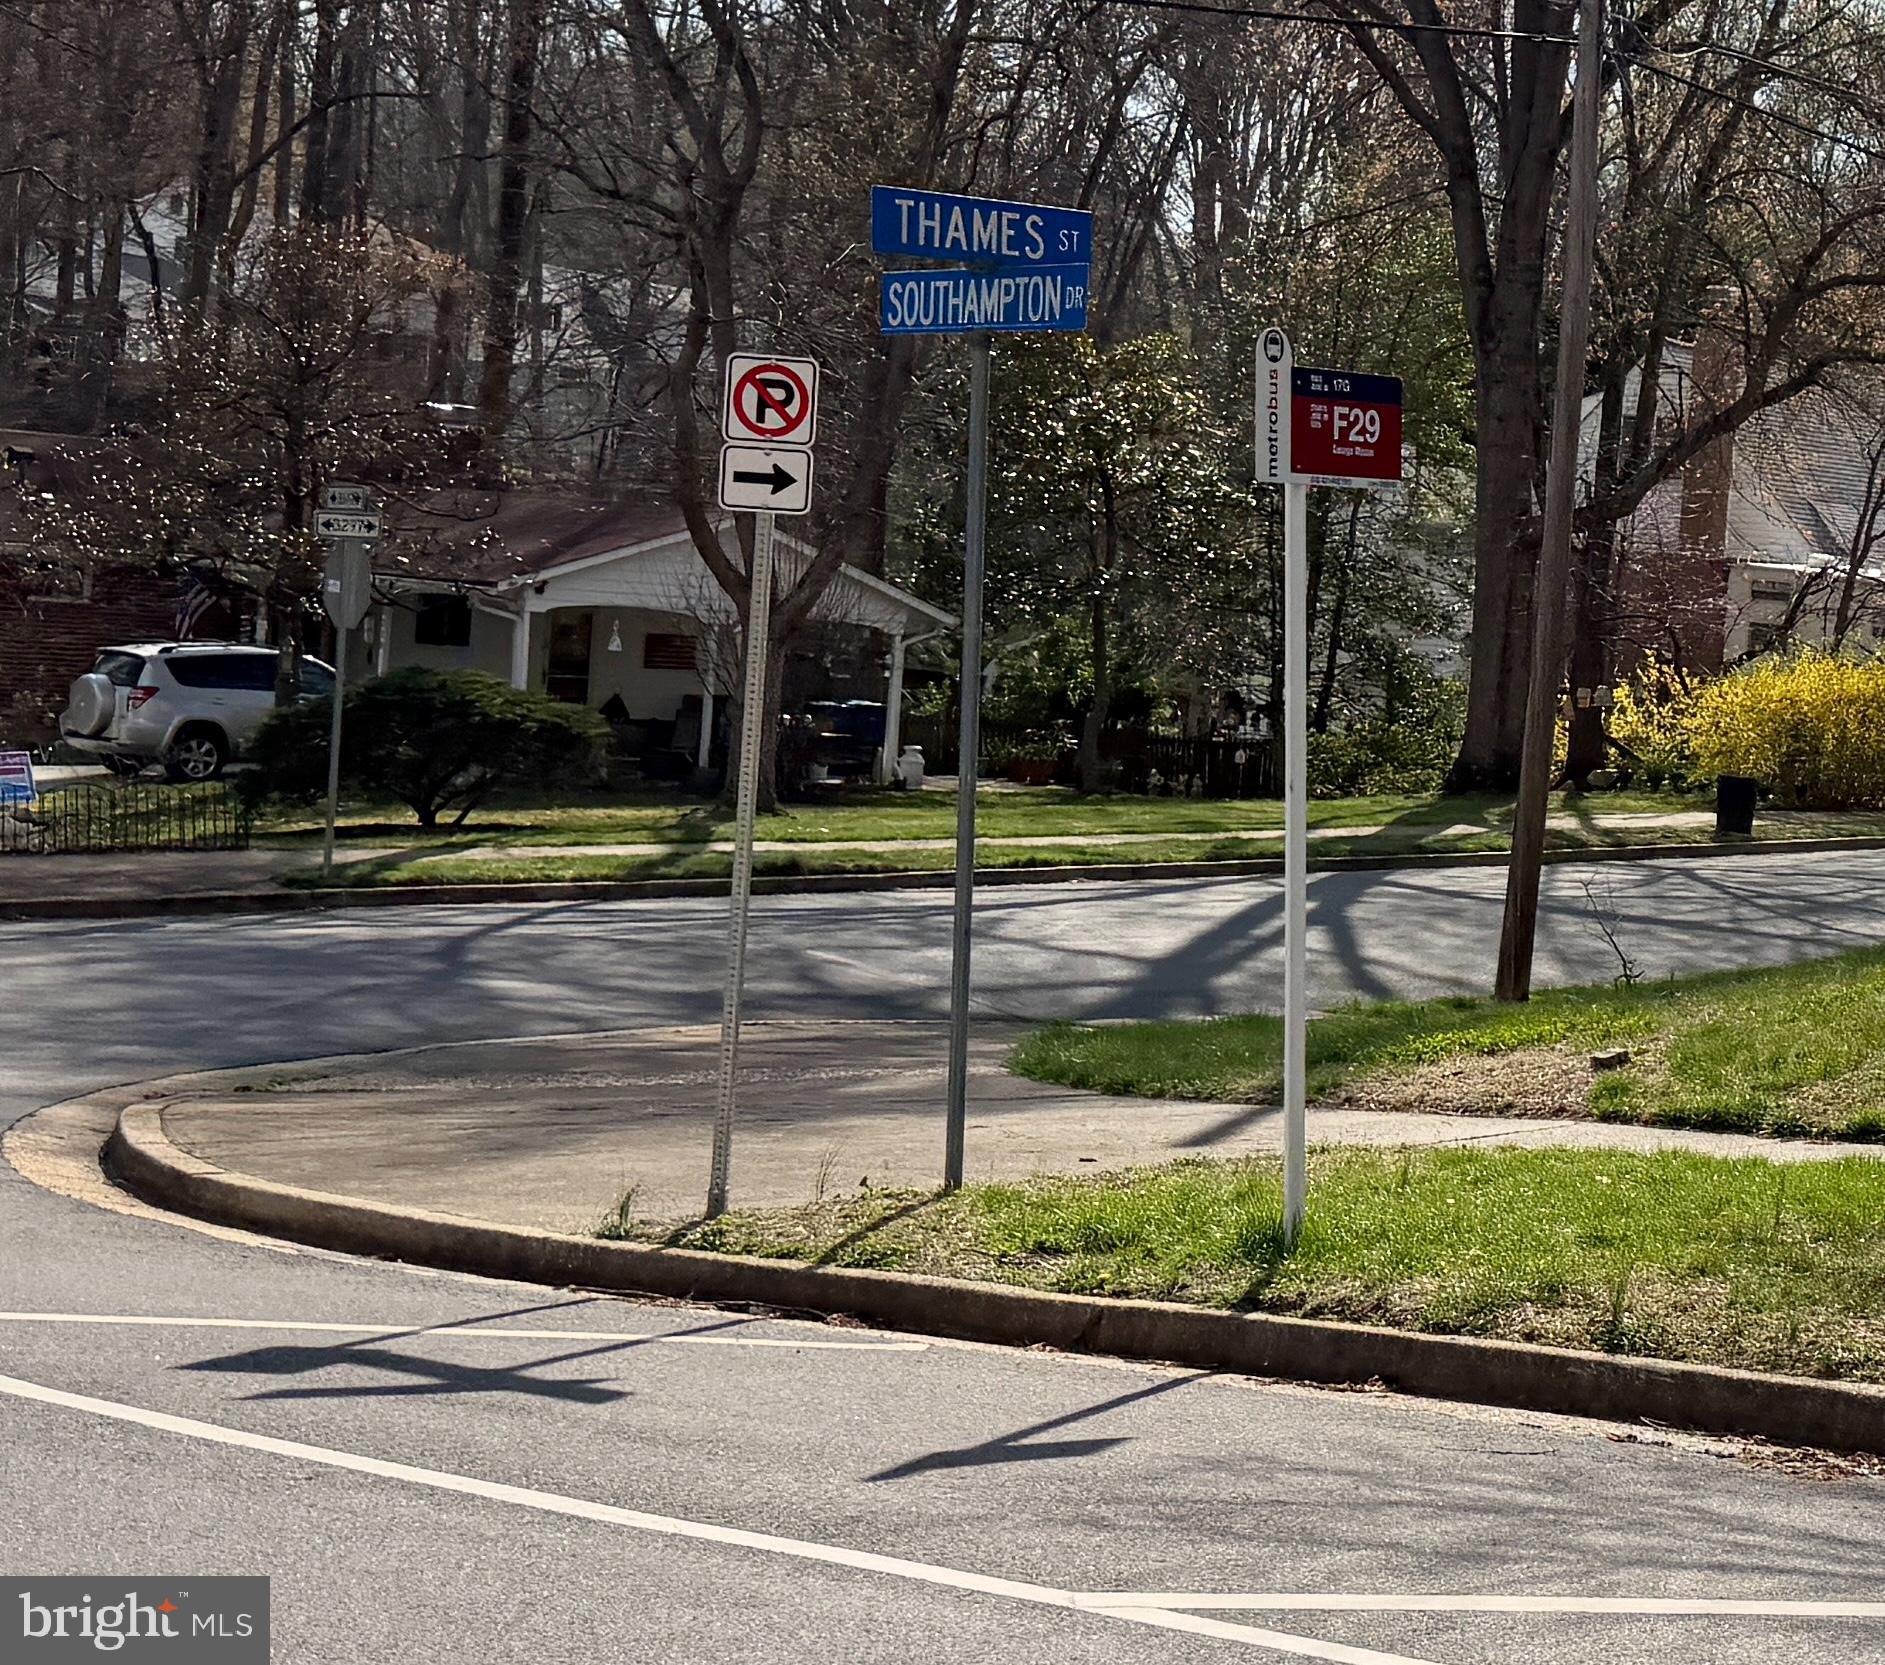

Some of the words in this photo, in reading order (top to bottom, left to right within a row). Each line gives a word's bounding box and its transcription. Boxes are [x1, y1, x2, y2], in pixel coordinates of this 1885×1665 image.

[895, 199, 1044, 260] THAMES
[1058, 230, 1080, 251] ST
[888, 275, 1061, 326] SOUTHAMPTON
[1065, 286, 1084, 309] DR
[756, 378, 795, 424] P
[1267, 369, 1279, 477] metrobus
[1333, 406, 1381, 443] F29
